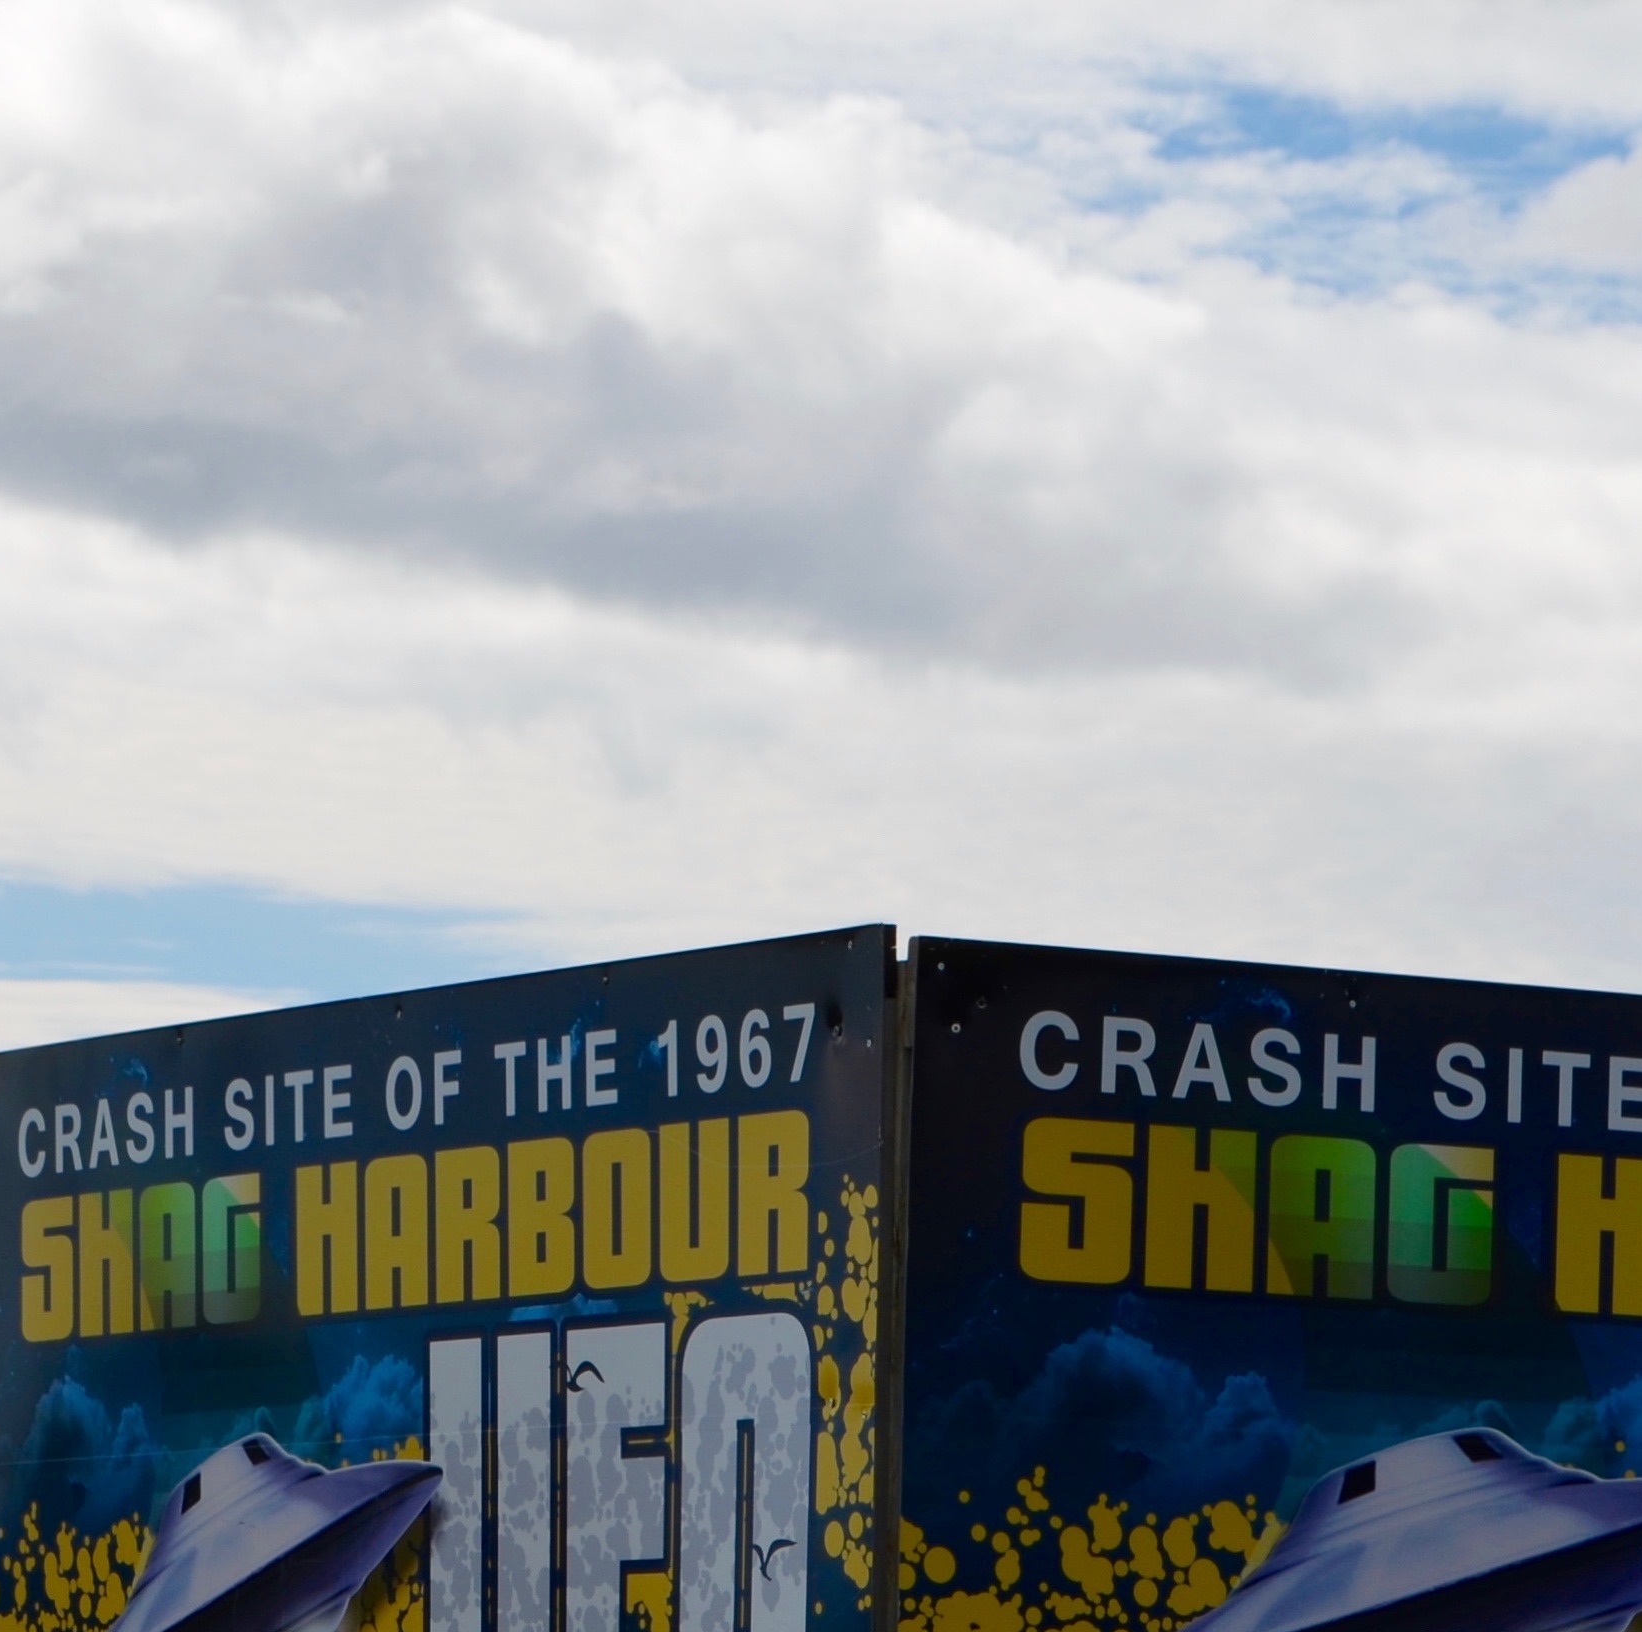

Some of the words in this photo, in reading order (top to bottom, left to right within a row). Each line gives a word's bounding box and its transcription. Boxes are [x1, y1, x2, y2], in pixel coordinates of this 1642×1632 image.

[17, 1085, 195, 1178] CRASH
[223, 1063, 354, 1150] SITE
[384, 1049, 463, 1131] OF
[493, 1028, 619, 1117] THE
[656, 1001, 817, 1098] 1967
[1018, 1009, 1377, 1113] CRASH
[19, 1172, 261, 1344] SHAG
[294, 1108, 811, 1318] HARBOUR
[1018, 1116, 1495, 1306] SHAG
